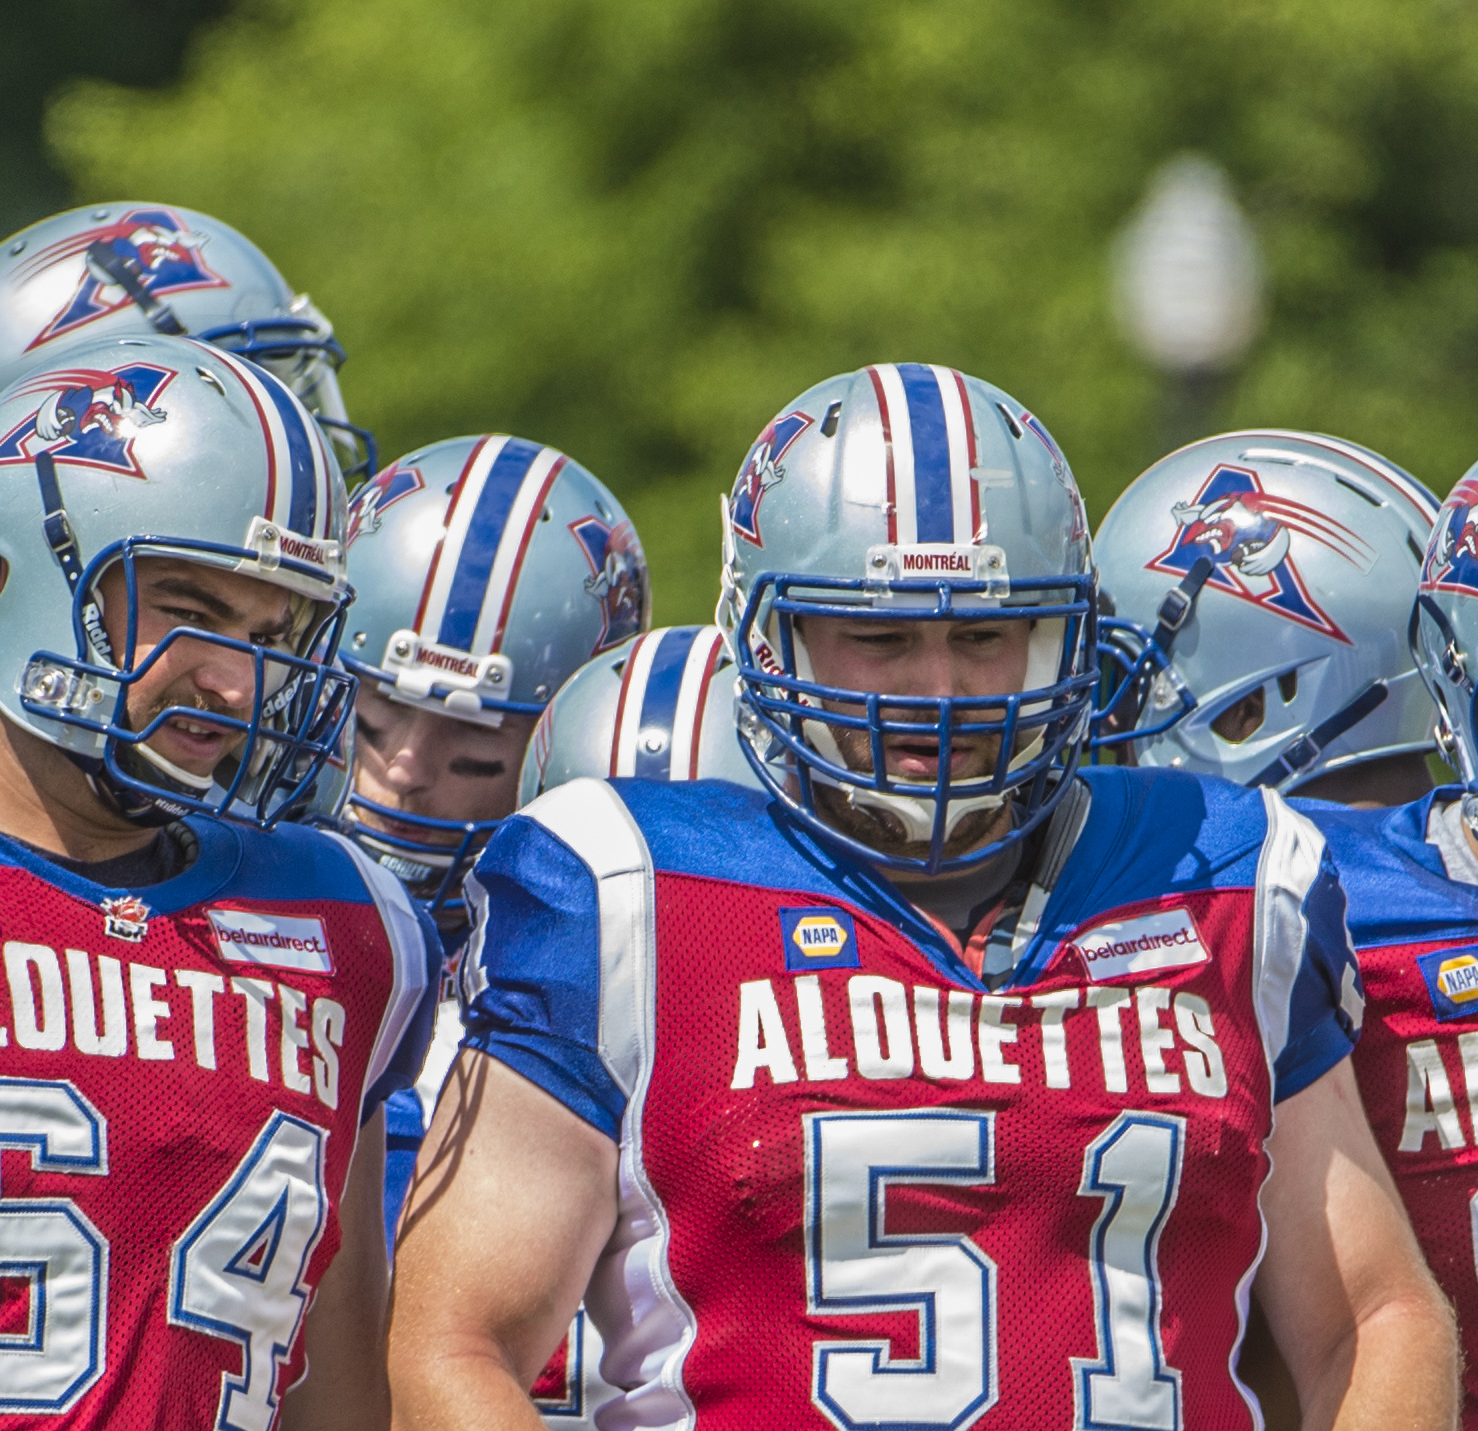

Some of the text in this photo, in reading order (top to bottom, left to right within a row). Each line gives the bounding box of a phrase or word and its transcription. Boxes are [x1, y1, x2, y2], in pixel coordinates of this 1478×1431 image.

[903, 551, 971, 571] MONTRÉAL
[802, 927, 839, 945] NAPA
[730, 974, 1228, 1098] ALOUETTES
